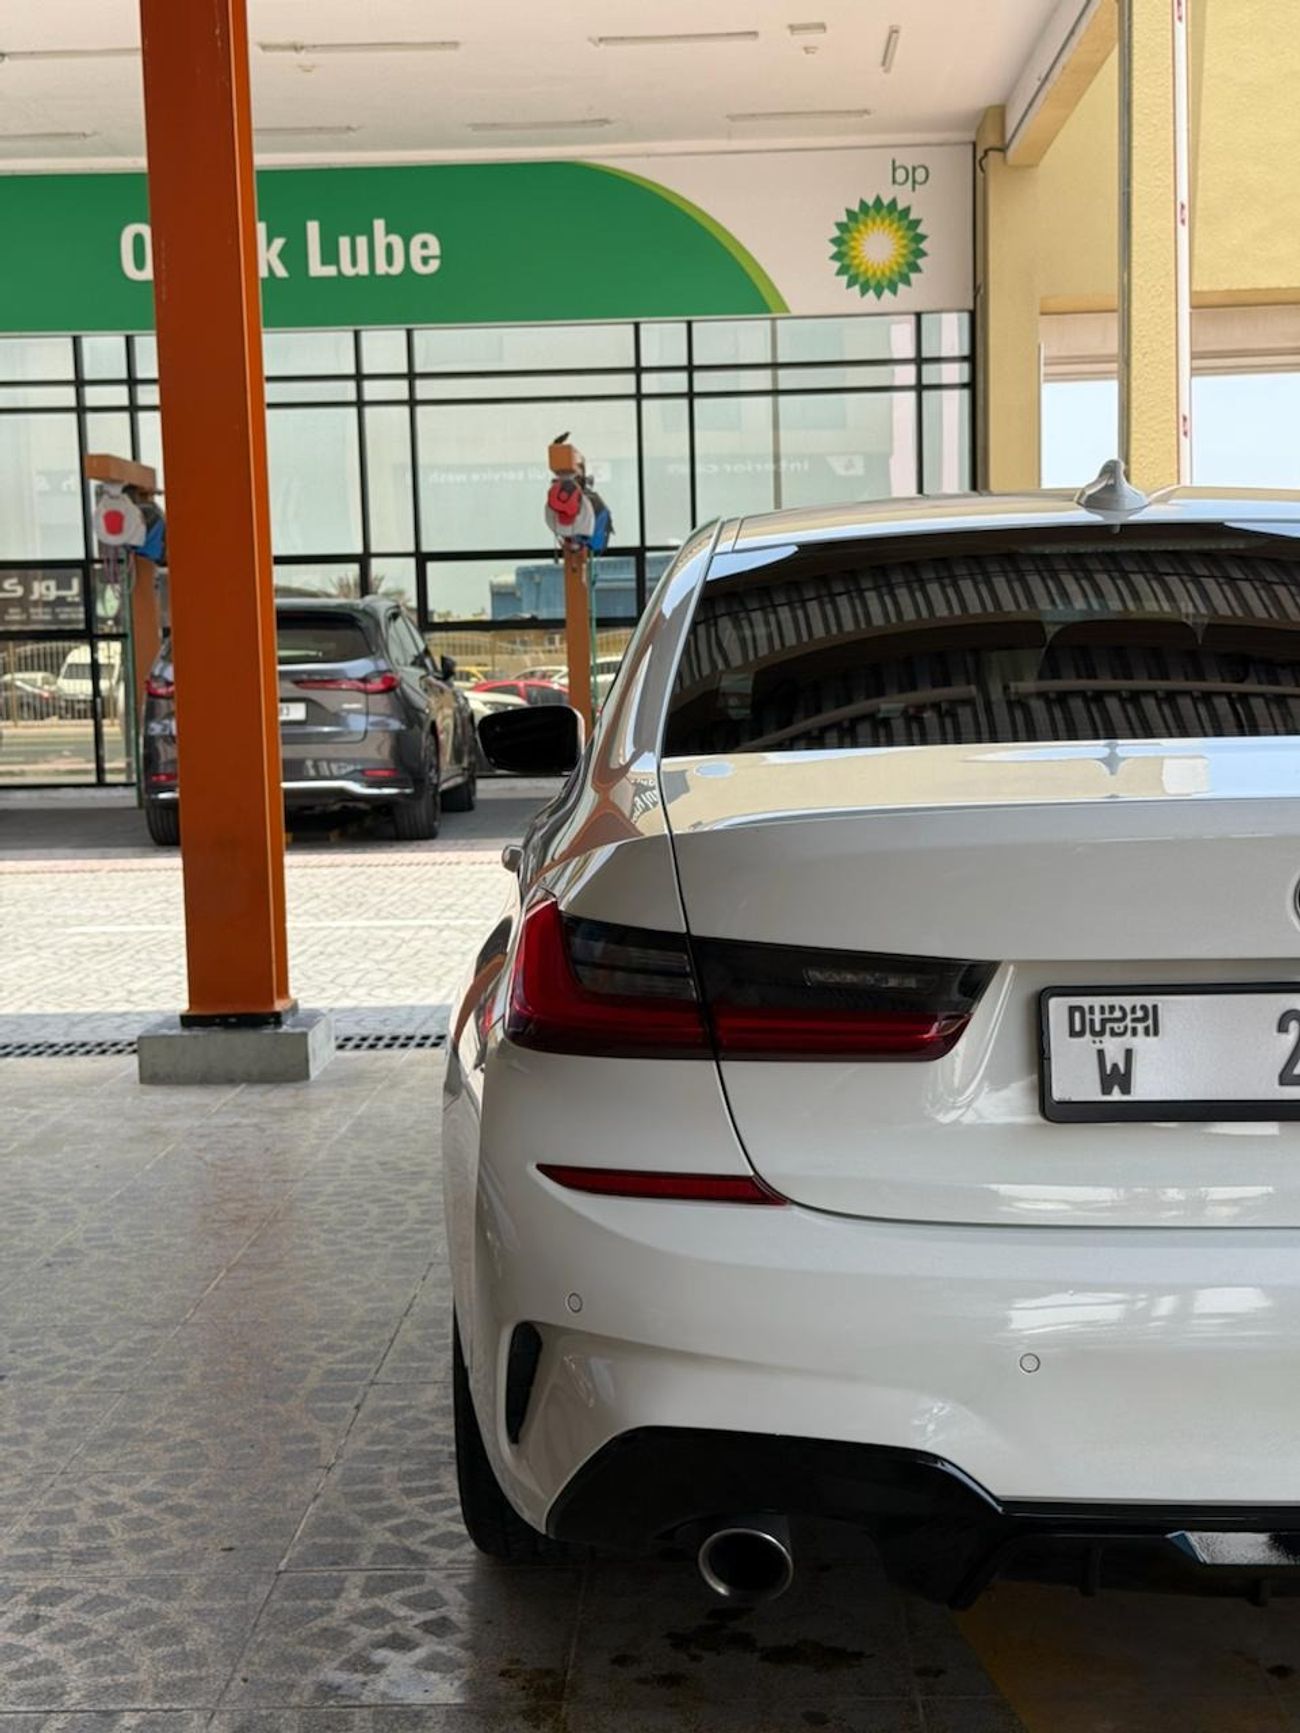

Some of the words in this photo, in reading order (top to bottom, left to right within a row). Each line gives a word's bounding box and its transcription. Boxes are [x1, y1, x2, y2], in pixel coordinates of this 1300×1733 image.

[891, 157, 930, 192] bp
[306, 218, 442, 277] Lube
[1068, 1003, 1160, 1040] DUBAI
[1096, 1047, 1133, 1096] W
